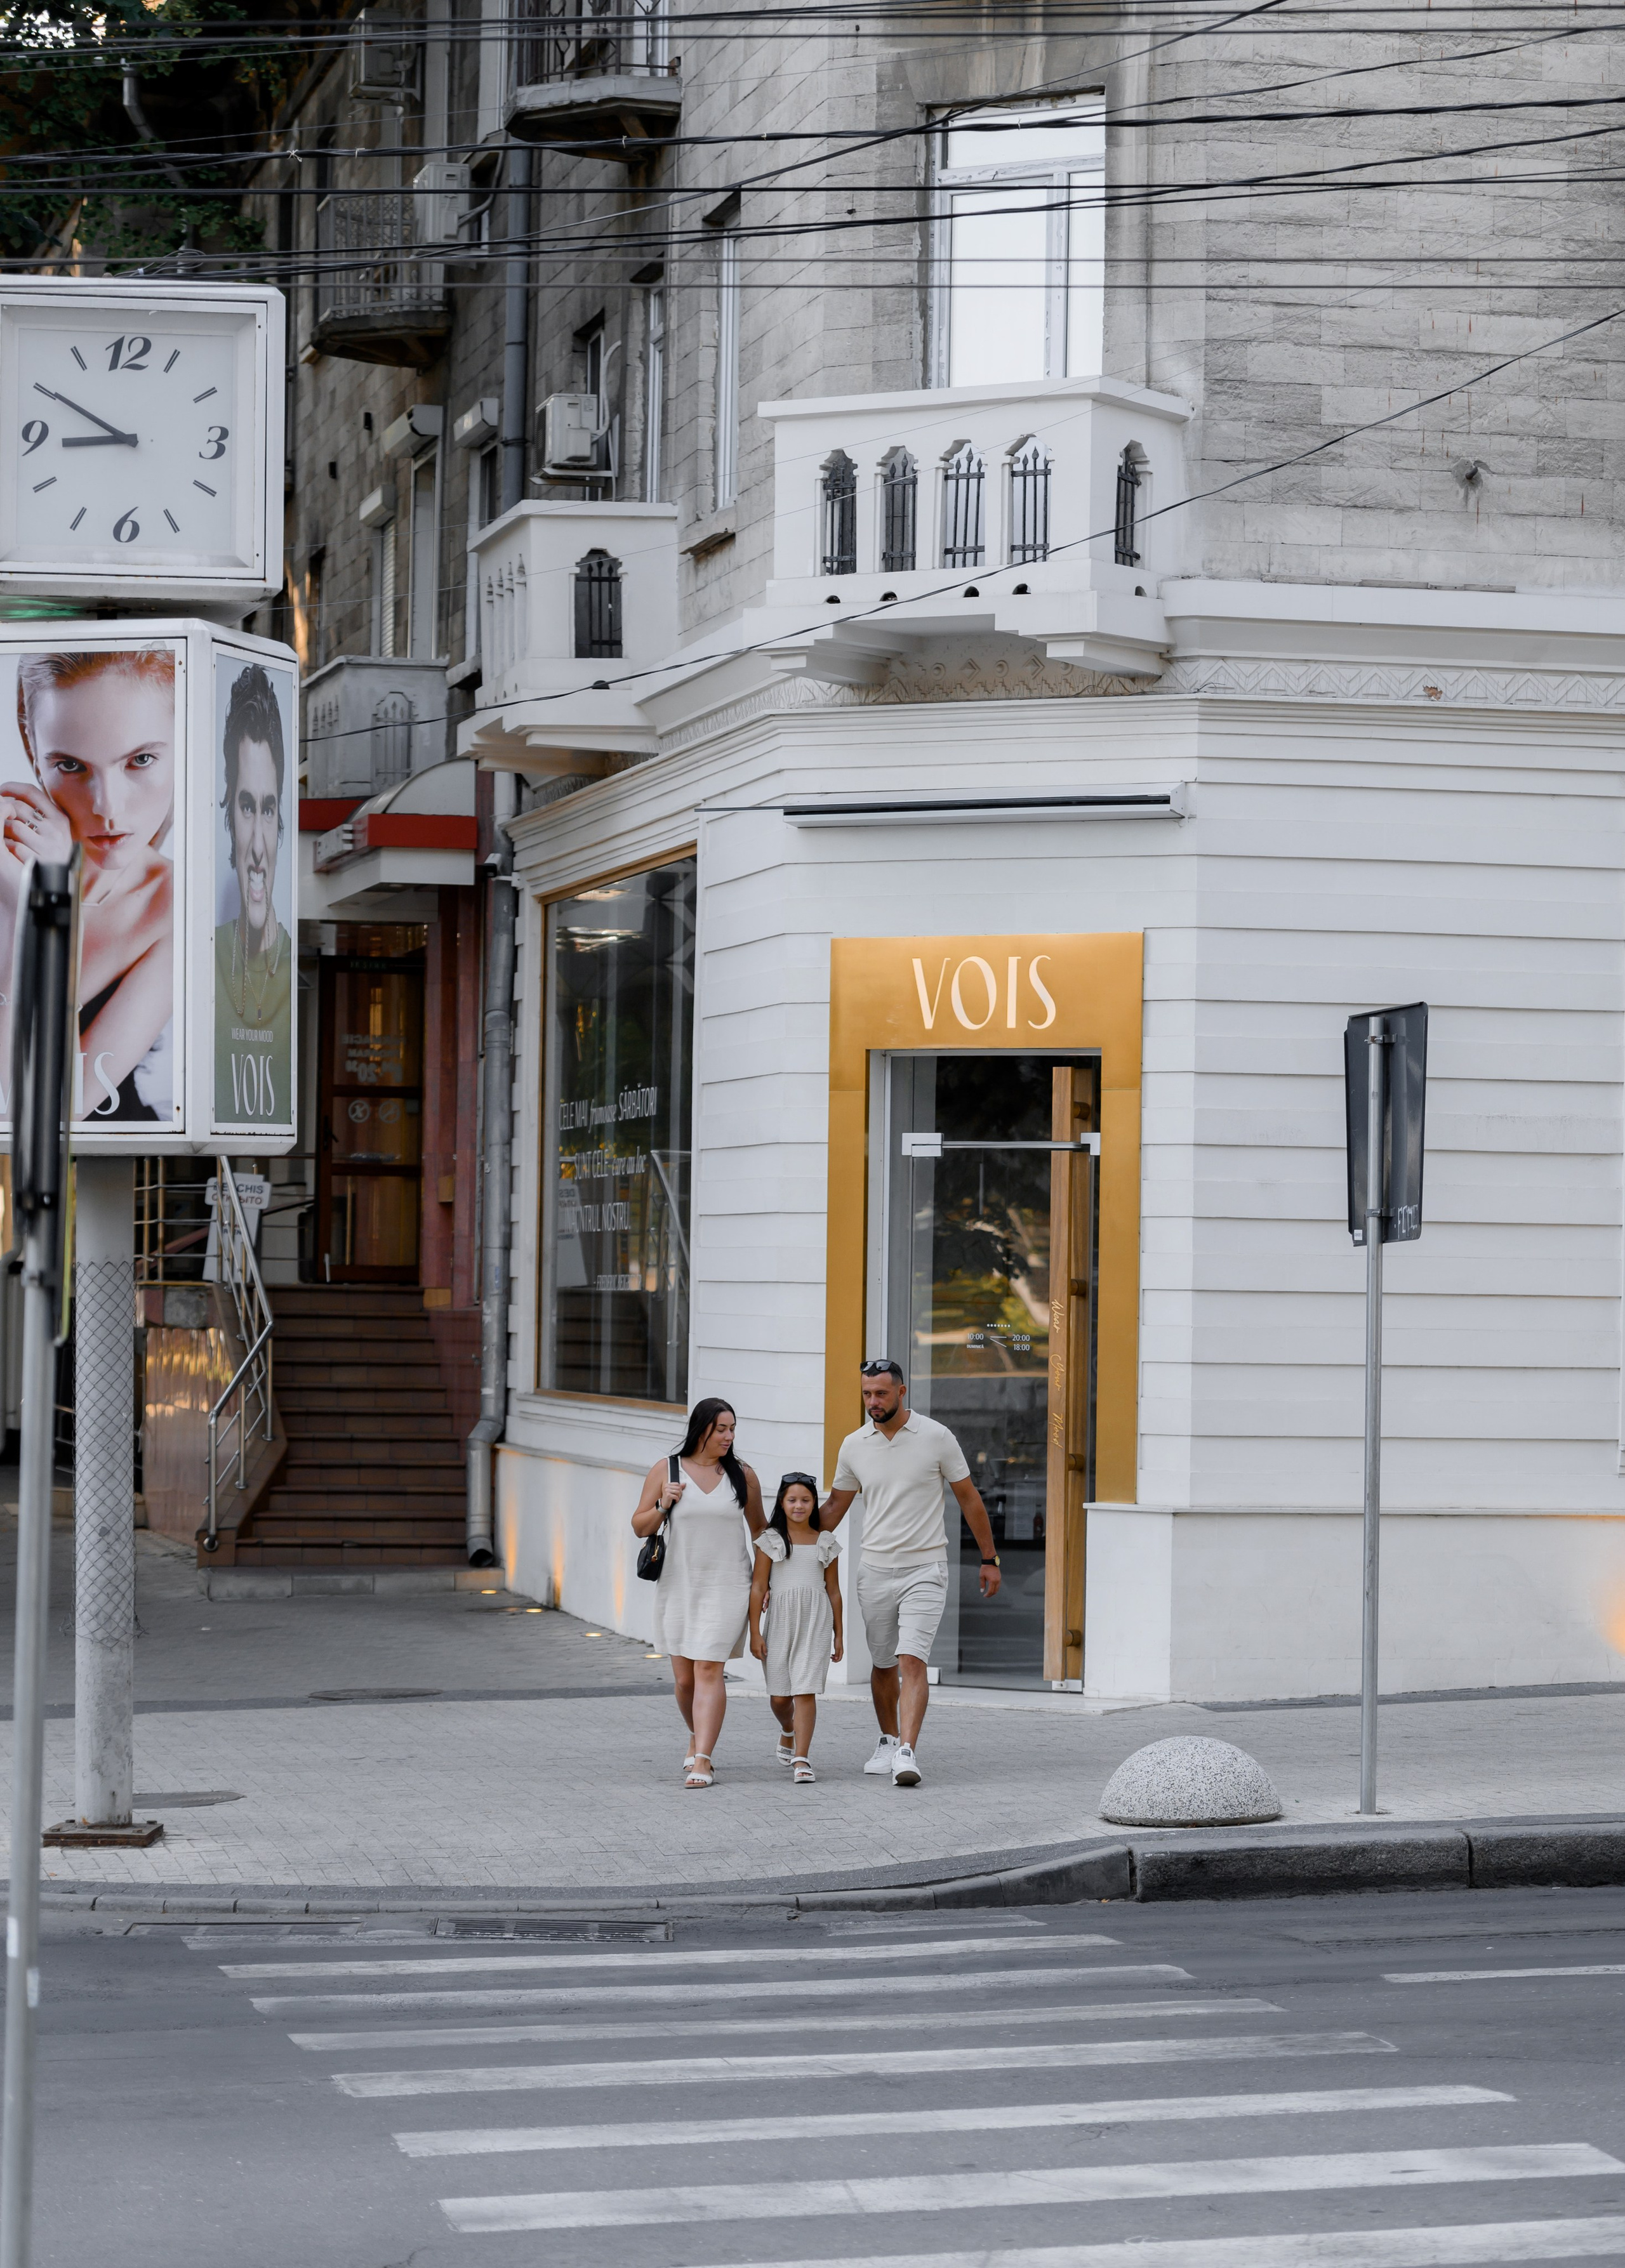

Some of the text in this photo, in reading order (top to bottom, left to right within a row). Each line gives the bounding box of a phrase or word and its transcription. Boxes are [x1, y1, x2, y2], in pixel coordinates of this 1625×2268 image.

[105, 335, 152, 372] 12
[22, 420, 49, 456] 9
[199, 426, 229, 459] 3
[112, 506, 140, 543] 6
[912, 954, 1056, 1030] VOIS
[231, 1028, 274, 1043] WEAR YOUR MOOD
[231, 1053, 275, 1116] VOIS
[559, 1083, 658, 1134] CELE MAI frumoase SĂRBĂTORI
[211, 1193, 262, 1205] ОТКЫТО
[213, 1182, 263, 1194] ECHIS
[1049, 1299, 1065, 1449] Wear Your Mood
